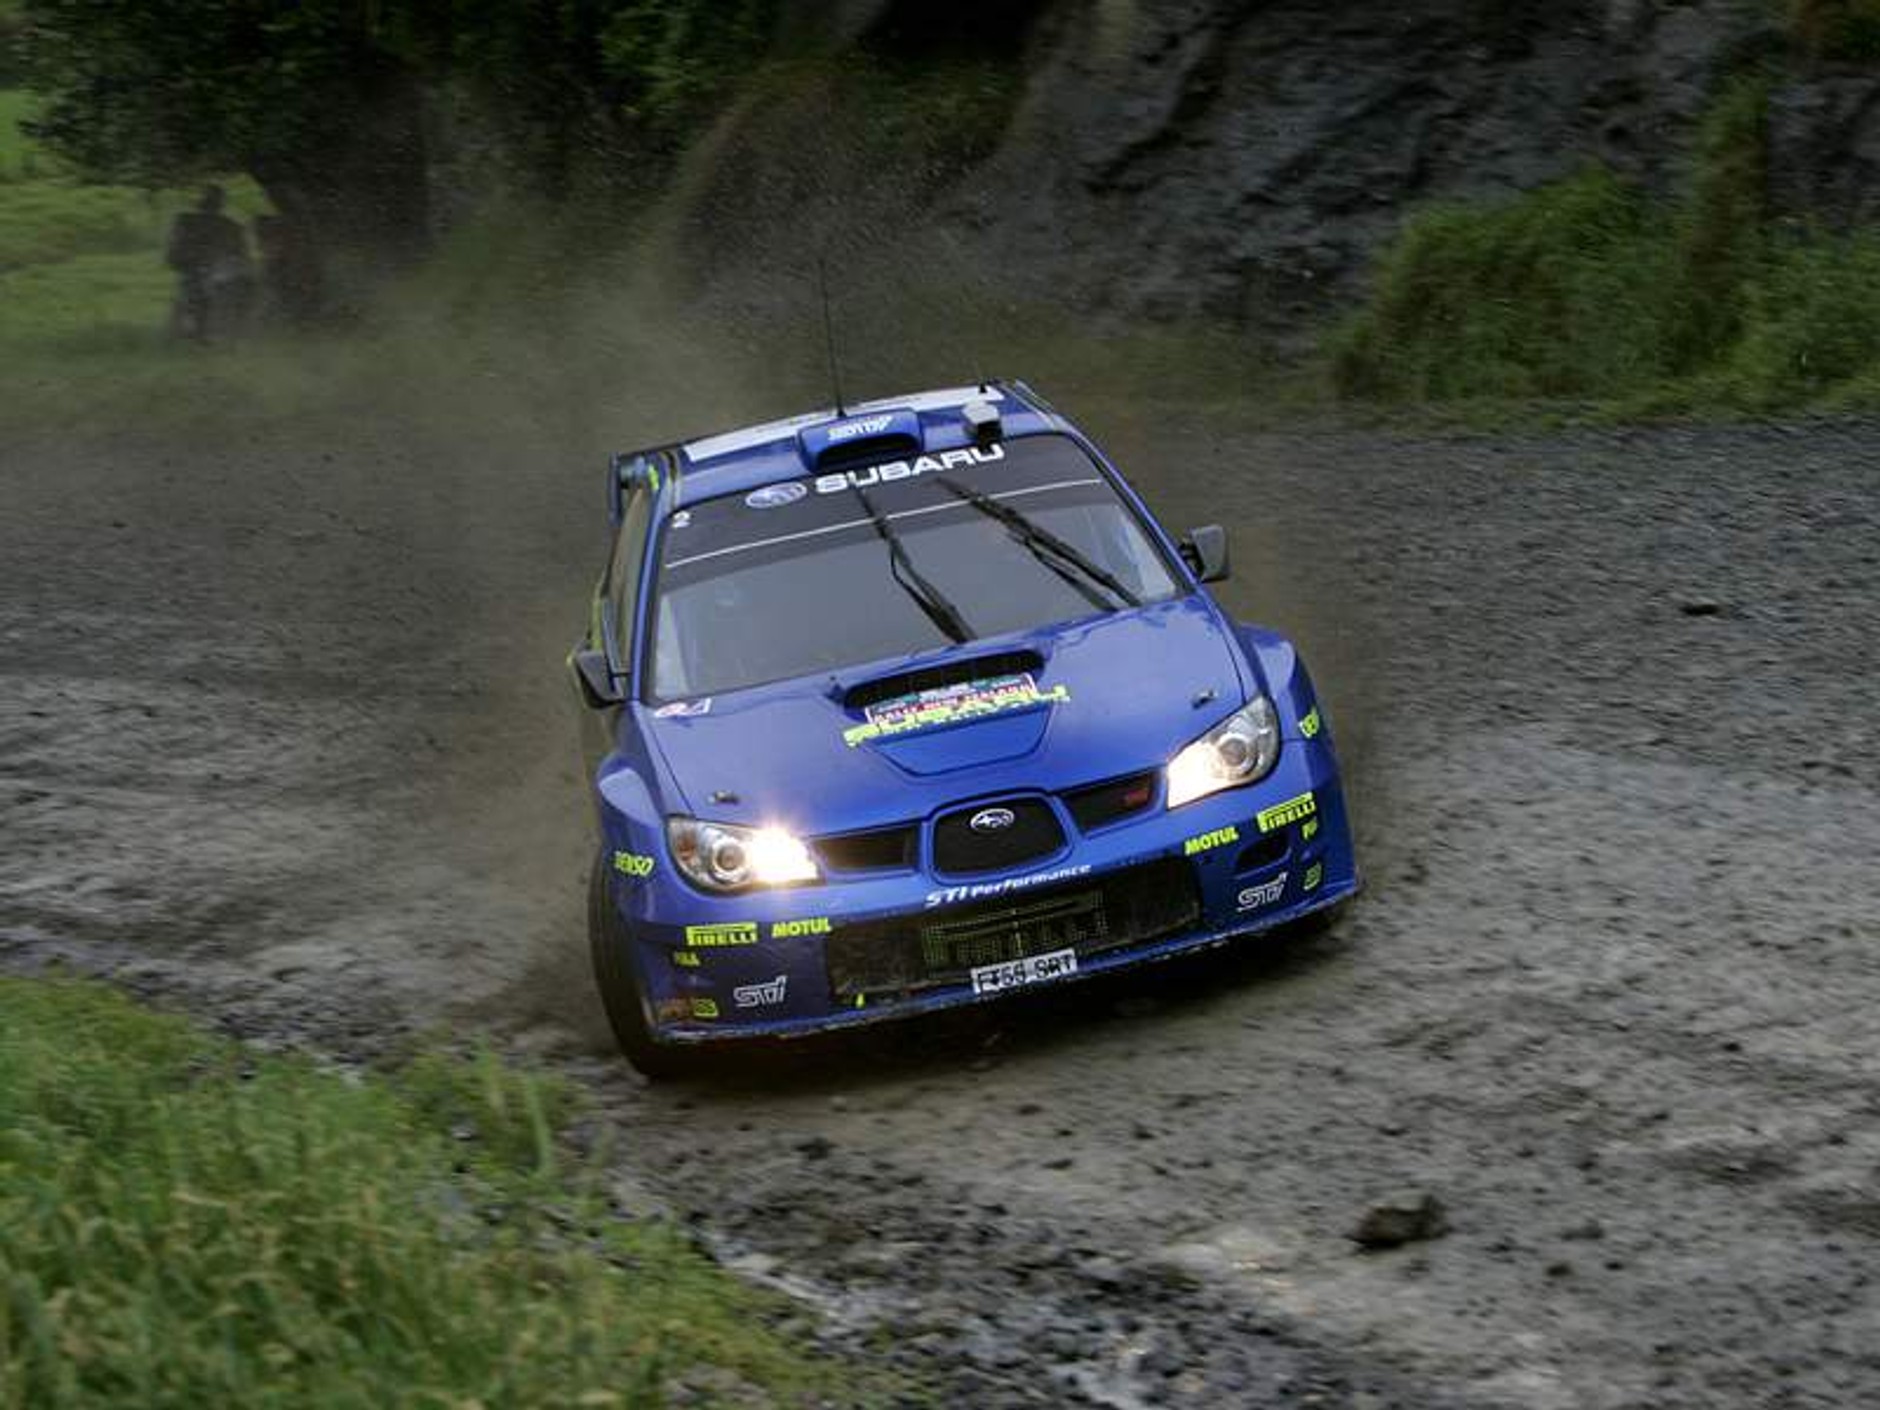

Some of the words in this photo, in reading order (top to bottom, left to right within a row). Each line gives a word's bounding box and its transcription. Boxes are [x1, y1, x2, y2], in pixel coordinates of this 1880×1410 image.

[815, 443, 1005, 494] SUBARU
[672, 510, 690, 529] 2
[1256, 791, 1316, 834] PIRELLI
[1185, 826, 1240, 856] MOTUL
[925, 885, 968, 909] STI
[970, 863, 1092, 899] Performance
[686, 921, 759, 947] PIRELLI
[771, 916, 833, 939] MOTUL
